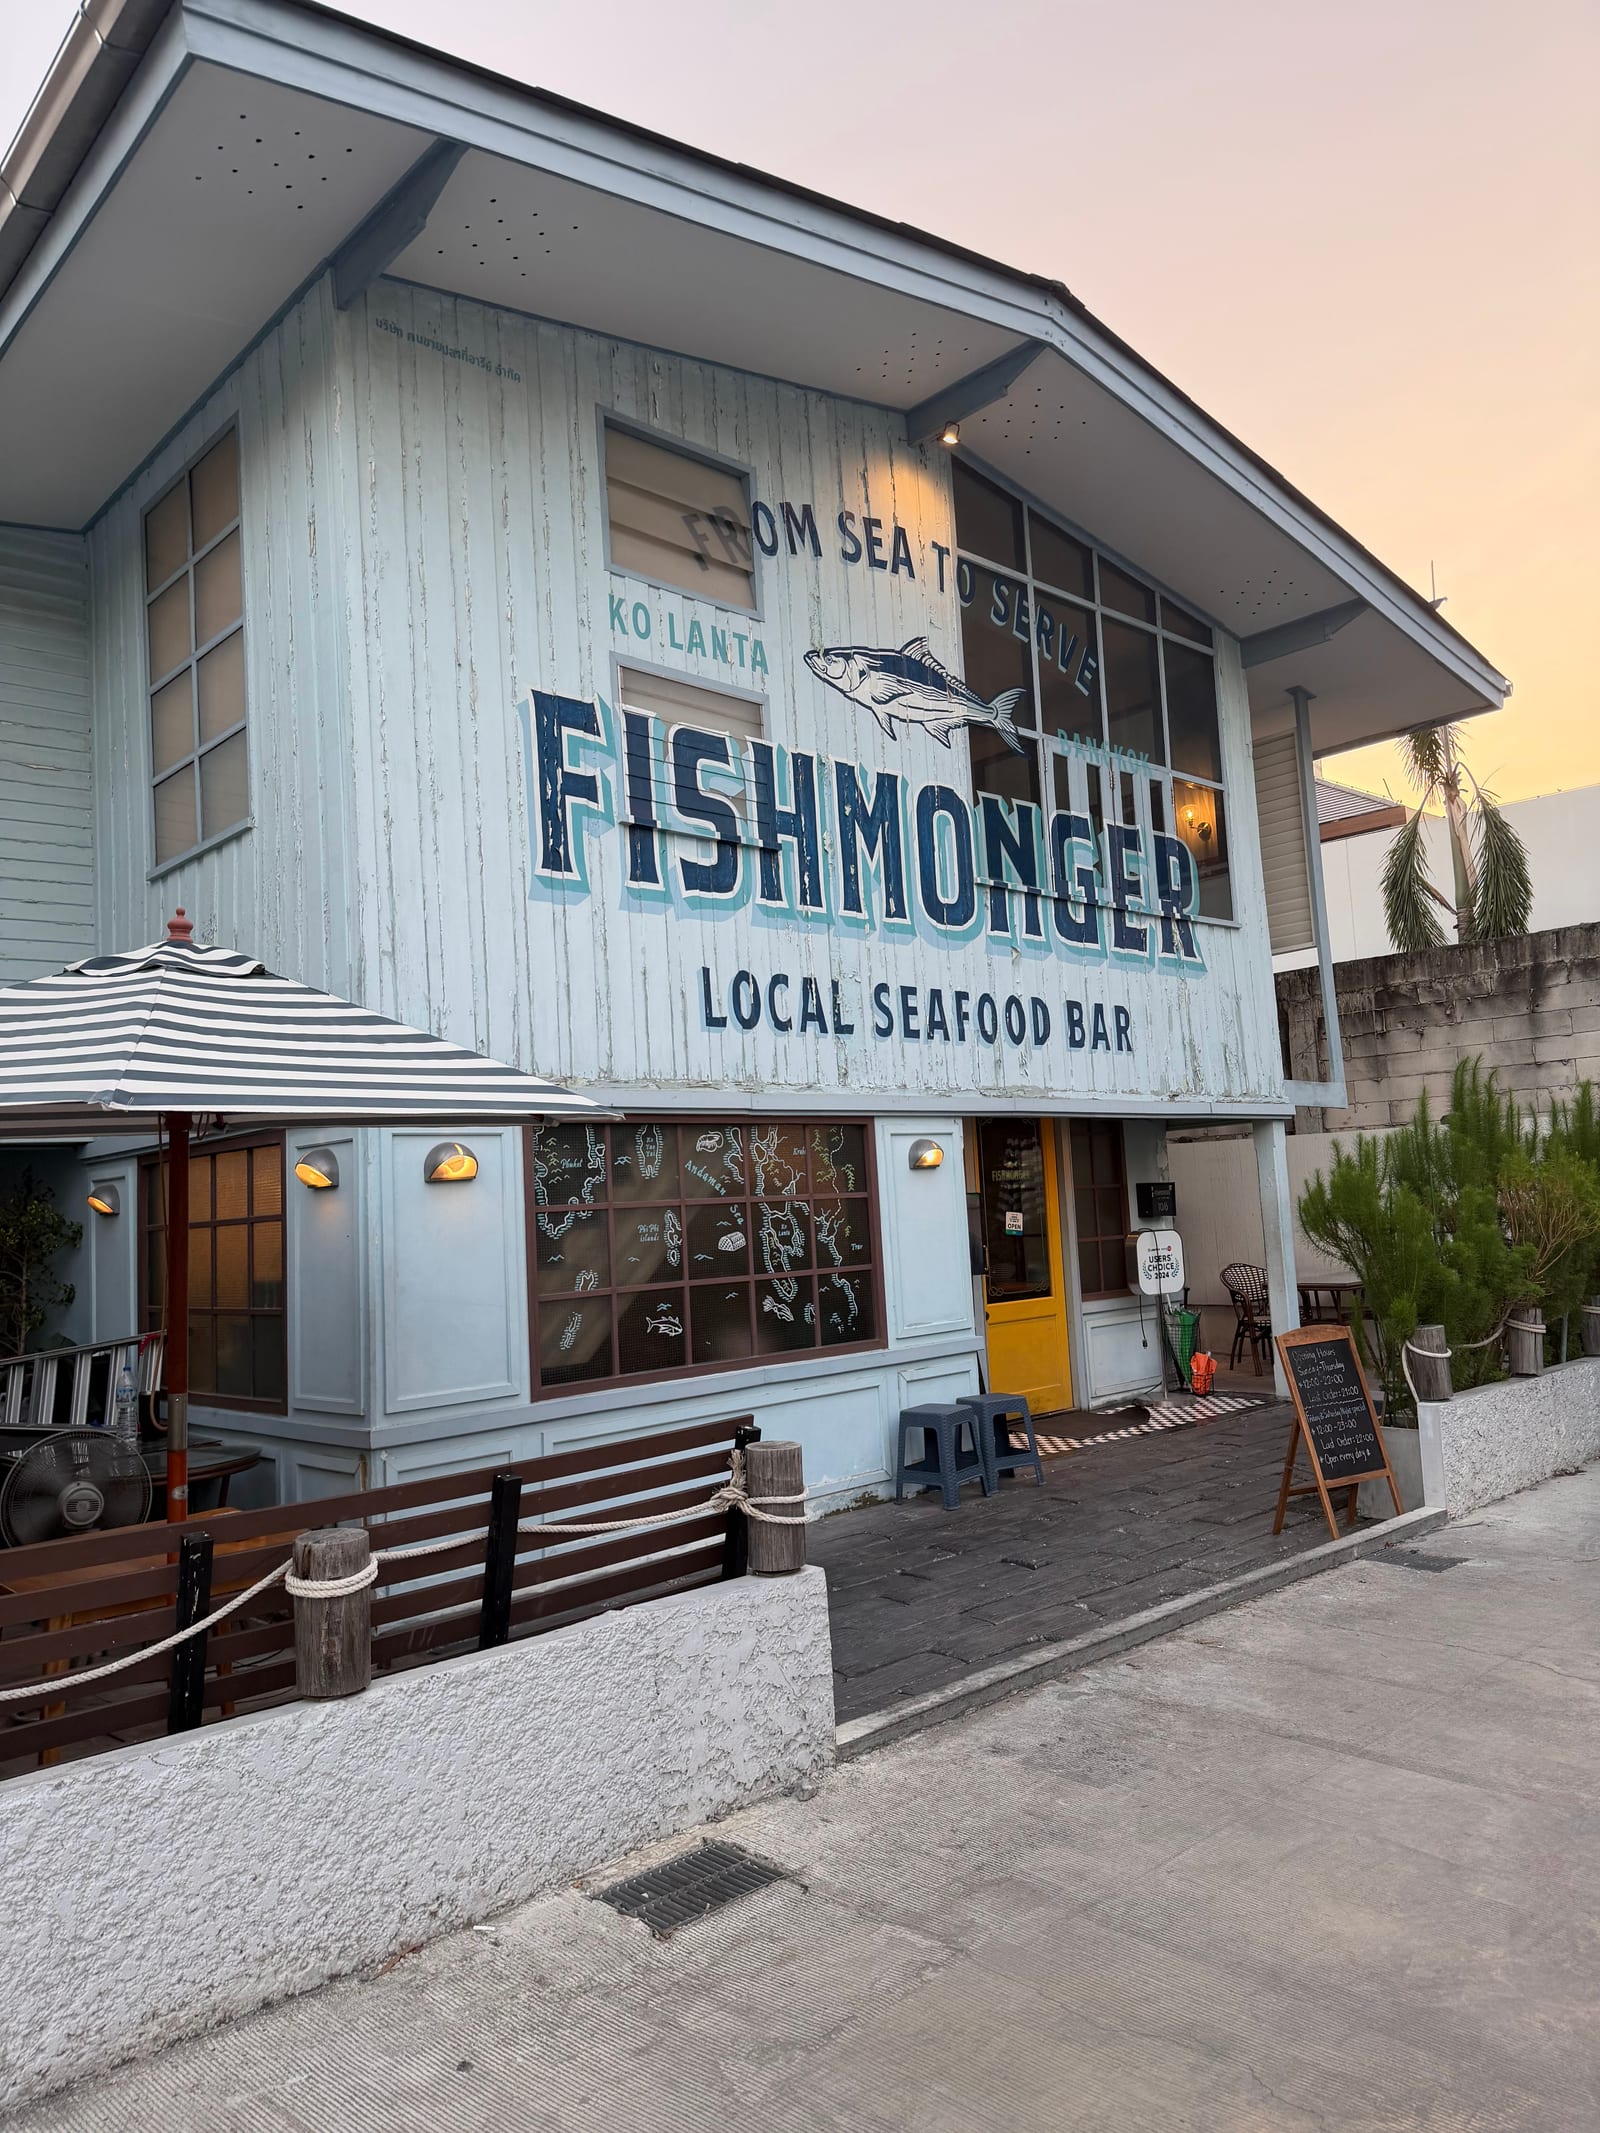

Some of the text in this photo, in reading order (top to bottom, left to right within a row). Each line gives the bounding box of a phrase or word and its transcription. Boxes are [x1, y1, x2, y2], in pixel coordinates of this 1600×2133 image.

[375, 317, 403, 339] บริษัท
[495, 364, 521, 383] จำกัด
[682, 500, 1098, 697] FROM SEA TO SERVE
[608, 593, 769, 675] KO LANTA
[1057, 728, 1153, 779] BANGKOK
[528, 688, 1205, 965] FISHMONGER
[701, 966, 1133, 1053] LOCAL SEAFOOD BAR
[685, 1160, 726, 1196] Andaman
[730, 1204, 744, 1225] Sea
[1148, 1263, 1174, 1272] CHOICE
[1320, 1438, 1334, 1449] Last
[1340, 1451, 1356, 1464] every
